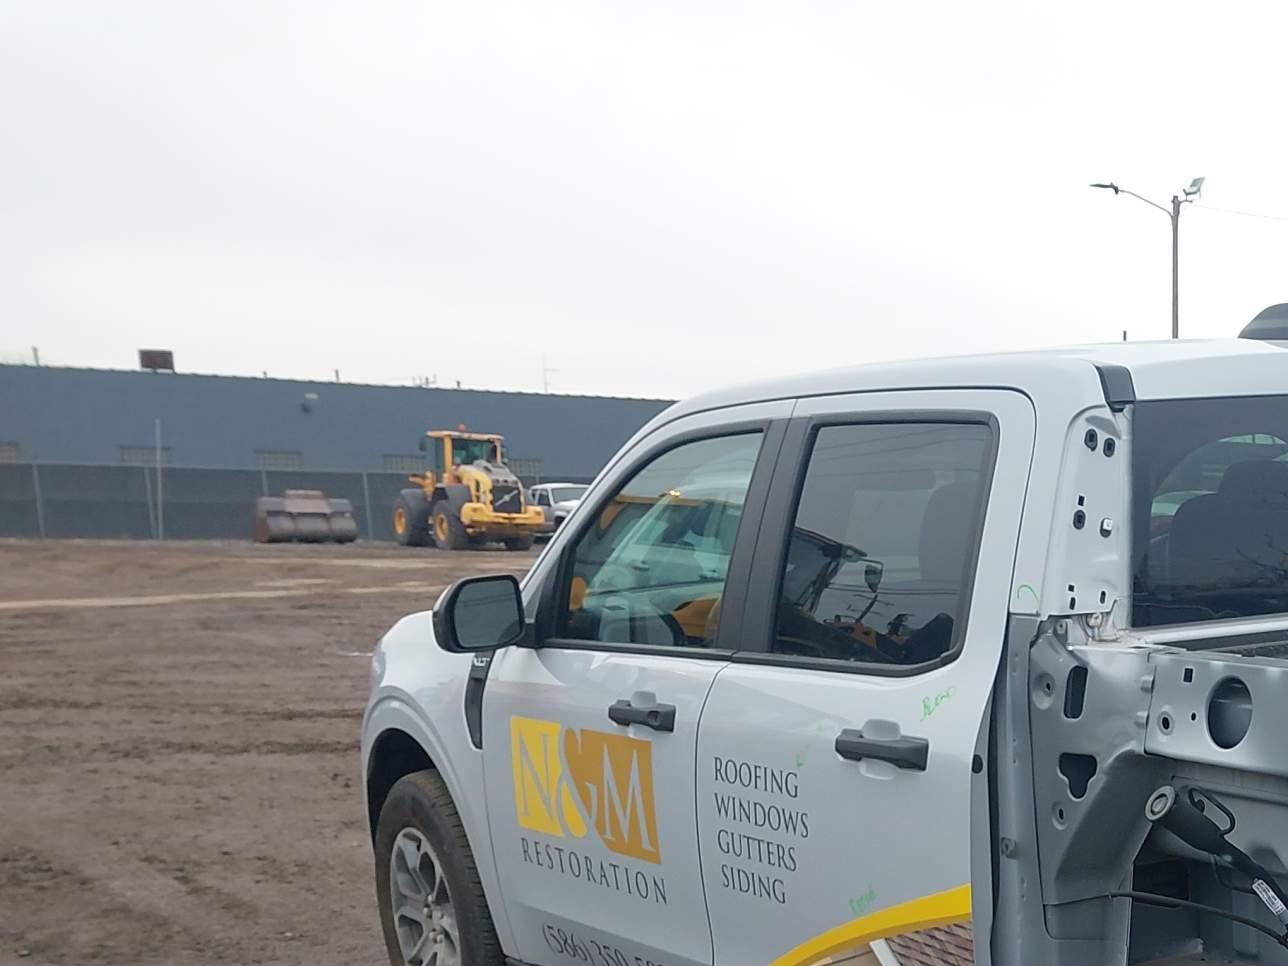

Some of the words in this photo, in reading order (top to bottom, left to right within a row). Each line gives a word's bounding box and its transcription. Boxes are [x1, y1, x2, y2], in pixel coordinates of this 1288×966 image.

[519, 727, 657, 852] N&M
[713, 756, 799, 799] ROOFING
[713, 791, 809, 839] WINDOWS
[520, 837, 668, 905] RESTORATION
[717, 828, 798, 873] GUTTERS
[720, 863, 786, 905] SIDING
[542, 923, 594, 966] (586)
